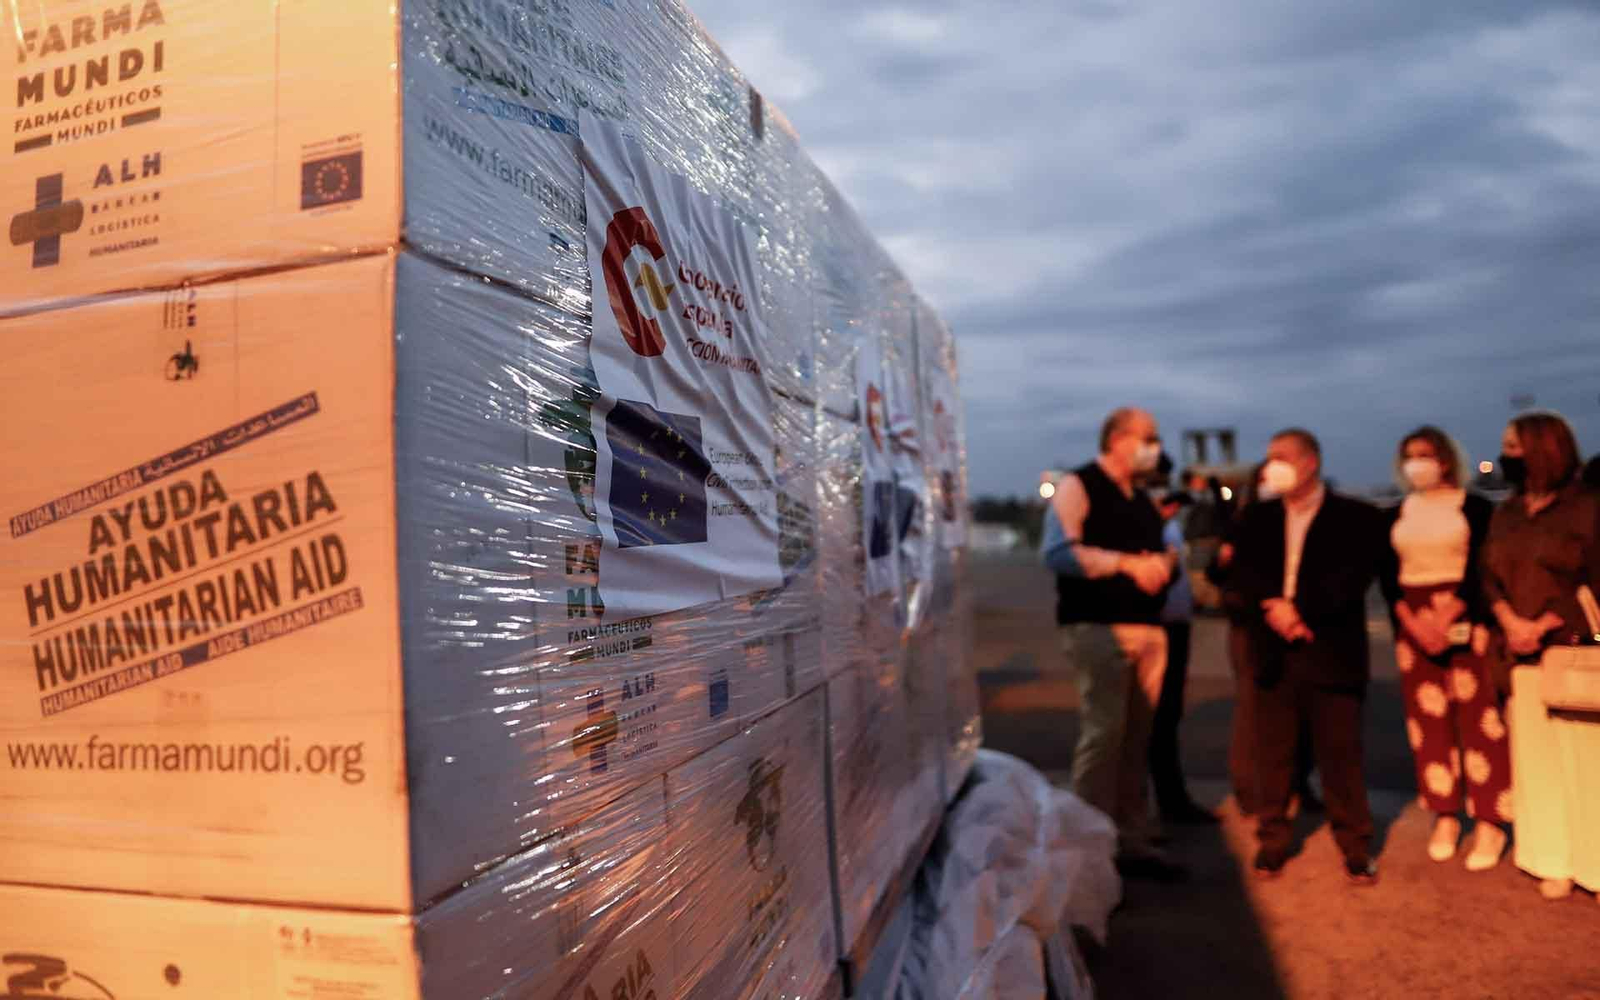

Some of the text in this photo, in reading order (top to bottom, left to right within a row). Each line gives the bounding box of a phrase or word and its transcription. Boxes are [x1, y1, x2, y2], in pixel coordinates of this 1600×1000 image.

[17, 0, 166, 63] FARMA
[17, 40, 164, 108] MUNDI
[14, 84, 163, 133] FARMACÉUTICOS
[57, 116, 116, 144] MUNDI
[92, 151, 161, 188] ALH
[11, 468, 142, 535] AYUDA HUMANITARIA
[88, 468, 228, 556] AYUDA
[24, 470, 337, 627] HUMANITARIA
[32, 532, 348, 692] HUMANITARIAN AID
[208, 588, 364, 661] AIDE HUMANITAIRE
[41, 658, 154, 717] HUMANITARIAN
[154, 651, 184, 678] AID
[7, 735, 366, 785] www.farmamundi.org
